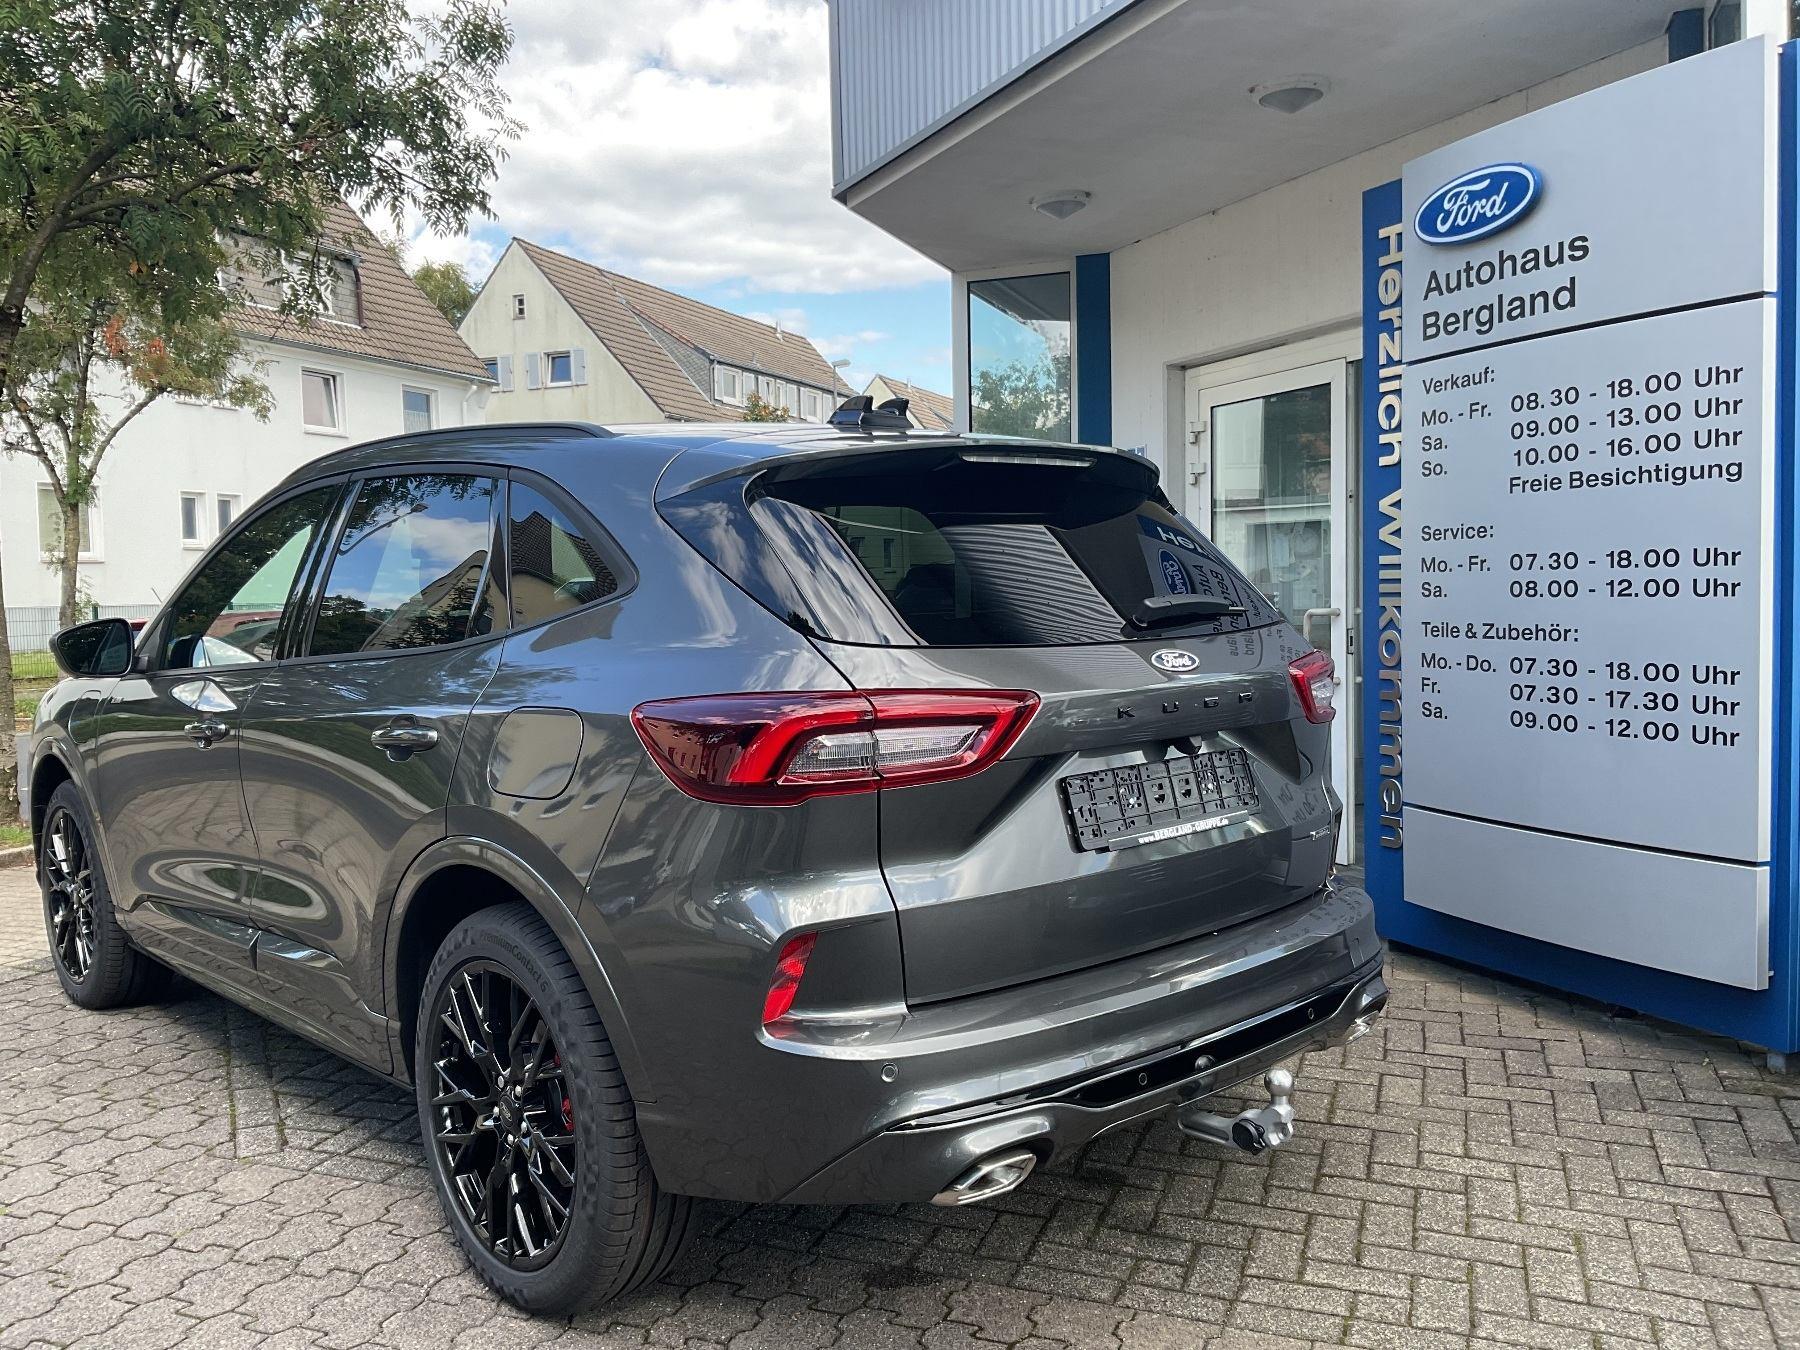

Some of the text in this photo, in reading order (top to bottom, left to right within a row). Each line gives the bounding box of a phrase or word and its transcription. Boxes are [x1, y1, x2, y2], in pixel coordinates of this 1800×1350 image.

[1436, 178, 1509, 233] Ford
[1422, 234, 1590, 301] Autohaus
[1422, 276, 1576, 342] Bergland
[1421, 408, 1453, 427] Mo.
[1469, 401, 1492, 420] Fr.
[1510, 386, 1580, 413] 08.30
[1606, 371, 1682, 400] 18.00
[1694, 366, 1744, 388] Uhr
[1422, 366, 1495, 395] Verkauf:
[1421, 435, 1448, 453] Sa.
[1510, 414, 1580, 440] 09.00
[1606, 401, 1682, 429] 13.00
[1694, 396, 1744, 419] Uhr
[1421, 460, 1448, 478] So.
[1513, 442, 1580, 467] 10.00
[1605, 432, 1682, 458] 16.00
[1693, 427, 1743, 450] Uhr
[1509, 461, 1743, 495] Freie Besichtigung
[1378, 223, 1403, 849] Herzlich Willkommen
[1421, 523, 1494, 542] Service:
[1420, 556, 1453, 573] Mo.
[1468, 554, 1491, 572] Fr.
[1509, 551, 1579, 572] 07.30
[1605, 547, 1680, 569] 18.00
[1692, 547, 1742, 568] Uhr
[1421, 581, 1448, 599] Sa.
[1509, 579, 1579, 599] 08.00
[1605, 577, 1680, 598] 12.00
[1692, 577, 1742, 598] Uhr
[1420, 621, 1579, 643] Teile & Zubehör:
[1161, 652, 1192, 668] Ford
[1421, 652, 1452, 670] Mo.
[1466, 654, 1497, 673] Do.
[1509, 656, 1578, 678] 07.30
[1604, 661, 1680, 683] 18.00
[1692, 664, 1741, 686] Uhr
[1421, 676, 1441, 694] Fr.
[1509, 683, 1579, 706] 07.30
[1604, 689, 1679, 713] 17.30
[1692, 694, 1741, 717] Uhr
[1421, 701, 1448, 720] Sa.
[1509, 709, 1579, 733] 09.00
[1604, 718, 1680, 742] 12.00
[1691, 724, 1741, 747] Uhr
